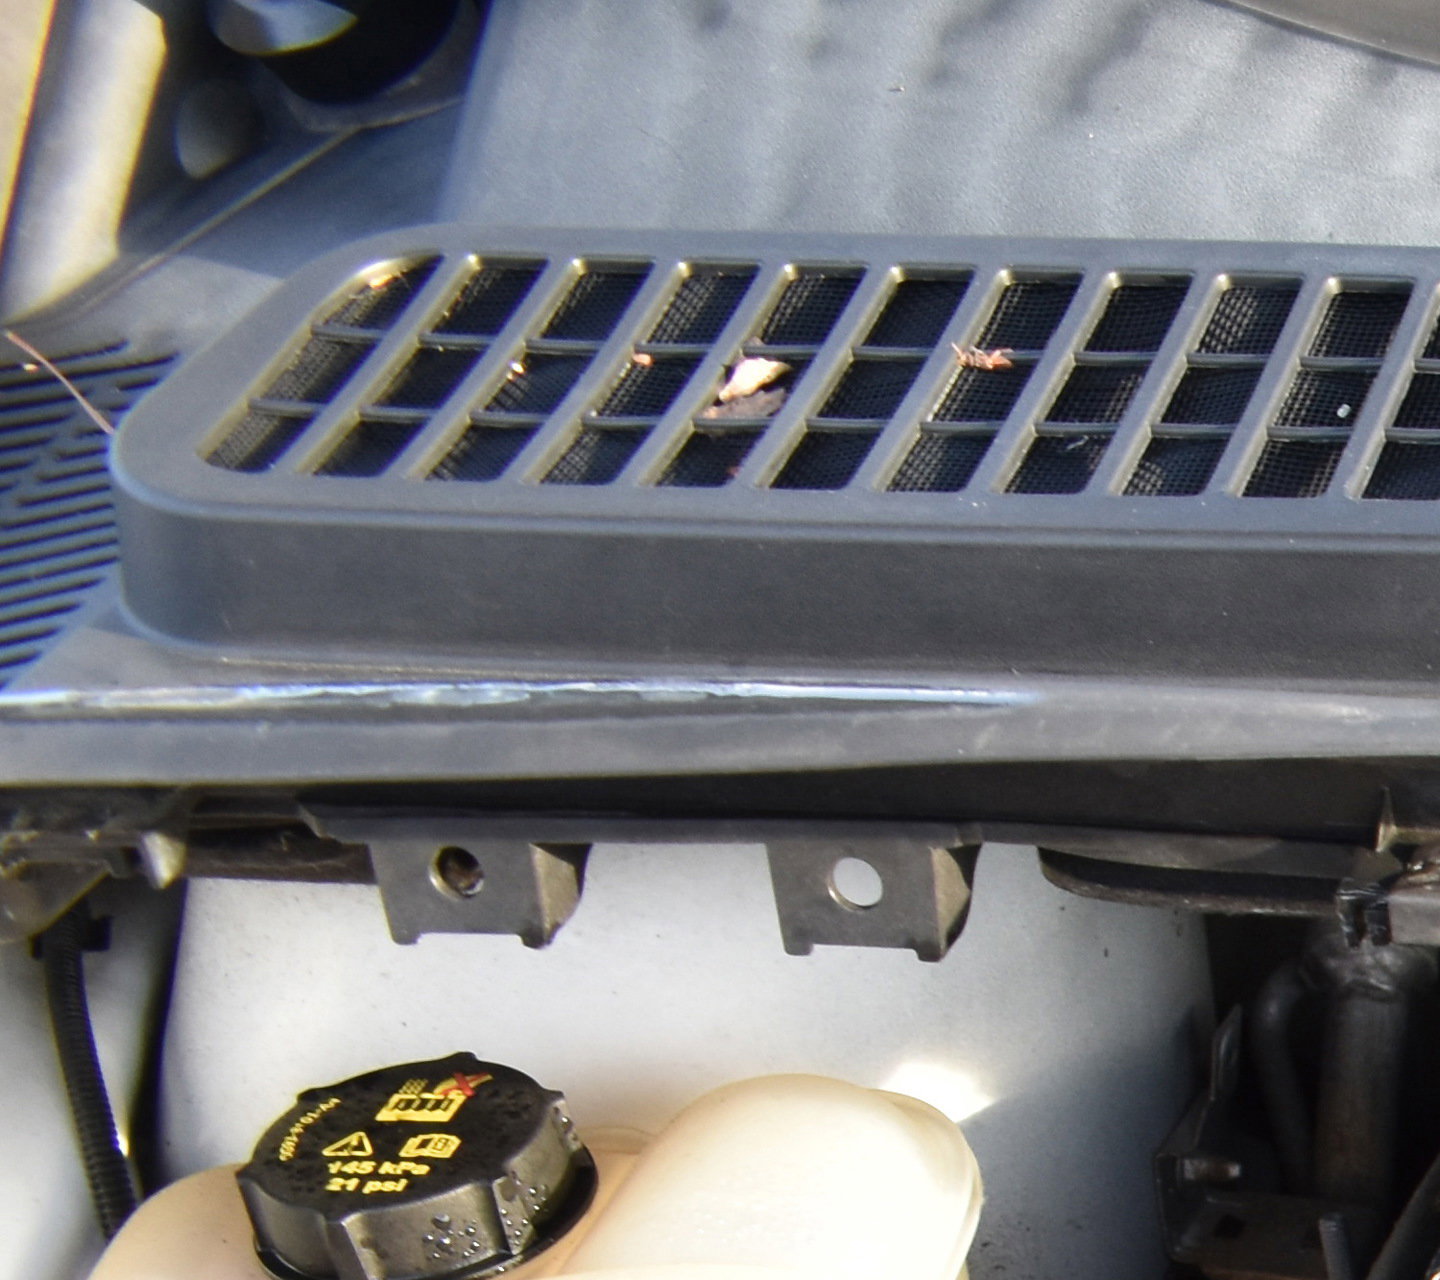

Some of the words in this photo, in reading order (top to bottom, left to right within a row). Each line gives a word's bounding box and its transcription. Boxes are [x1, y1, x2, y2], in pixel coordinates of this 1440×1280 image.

[327, 1160, 377, 1175] 145
[378, 1160, 431, 1175] kPa
[325, 1177, 361, 1191] 21
[362, 1178, 409, 1195] psi
